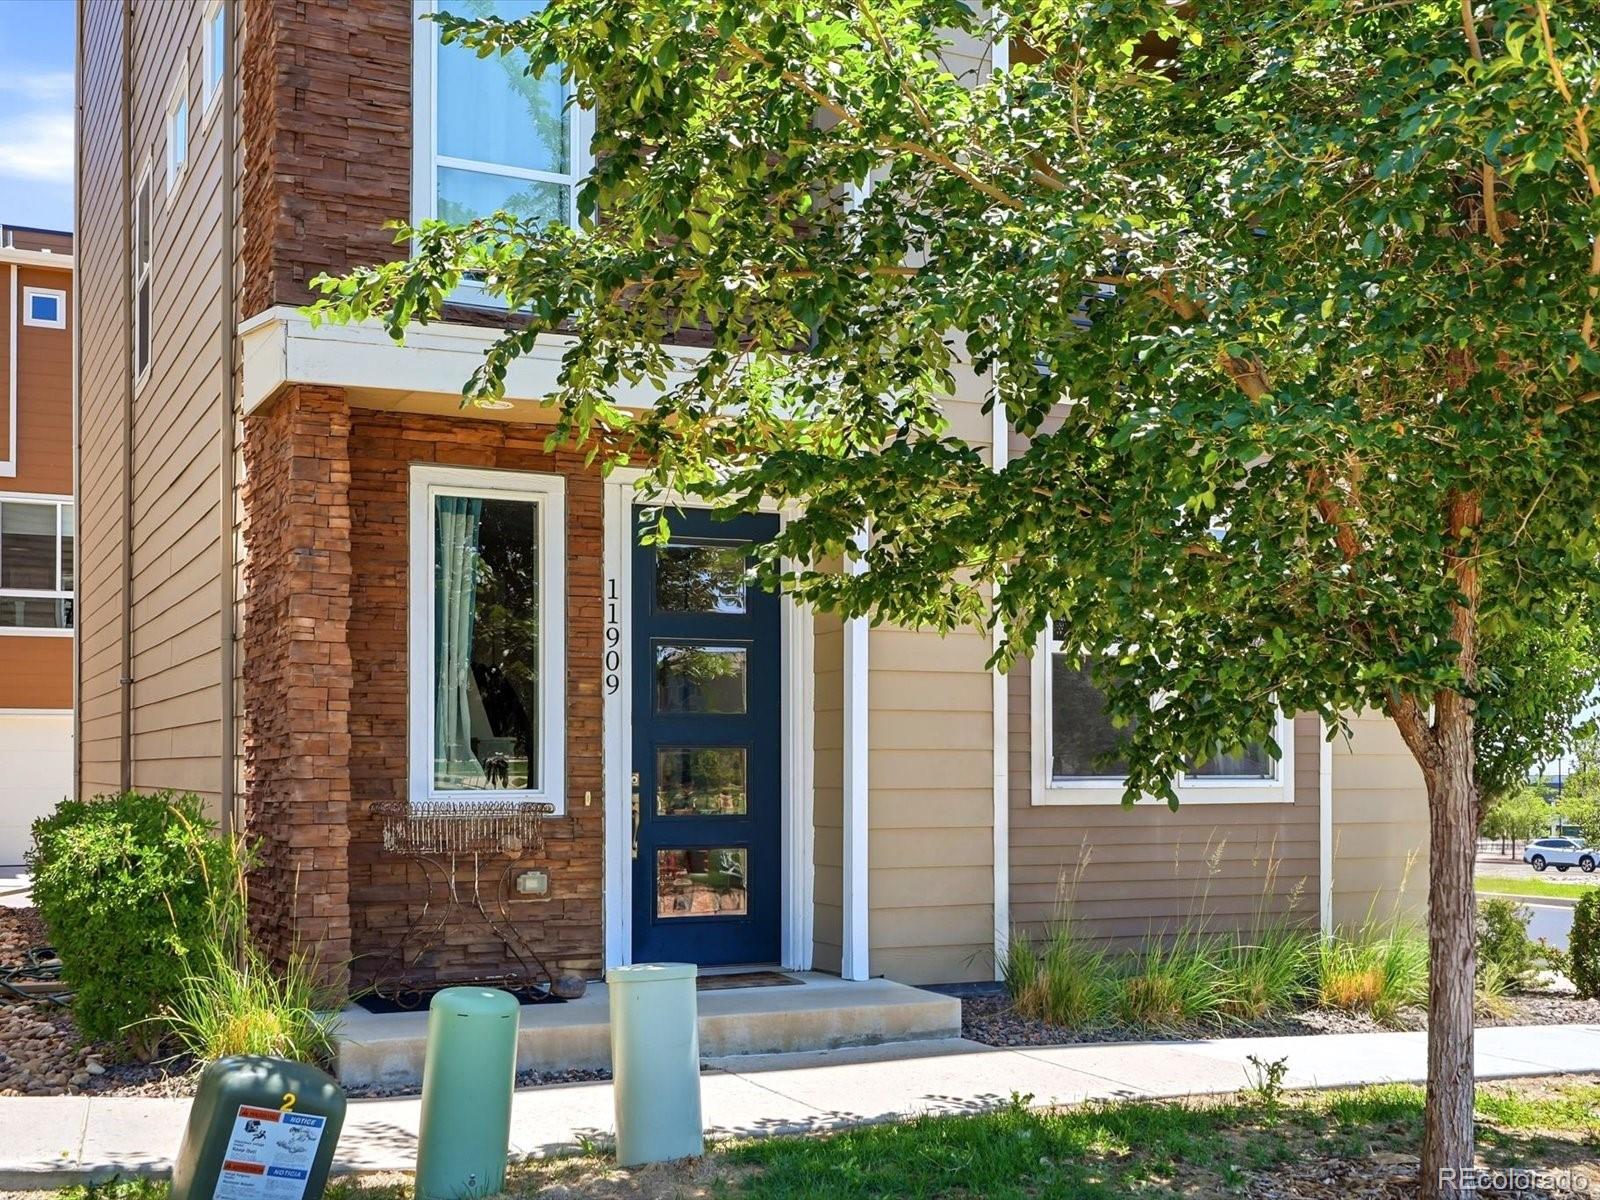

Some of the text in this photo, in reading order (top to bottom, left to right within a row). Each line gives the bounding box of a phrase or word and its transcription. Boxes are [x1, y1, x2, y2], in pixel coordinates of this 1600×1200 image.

[606, 578, 620, 695] 11909
[280, 1093, 296, 1112] 2
[289, 1116, 317, 1126] NOTICE
[273, 1169, 302, 1178] NOTICIA
